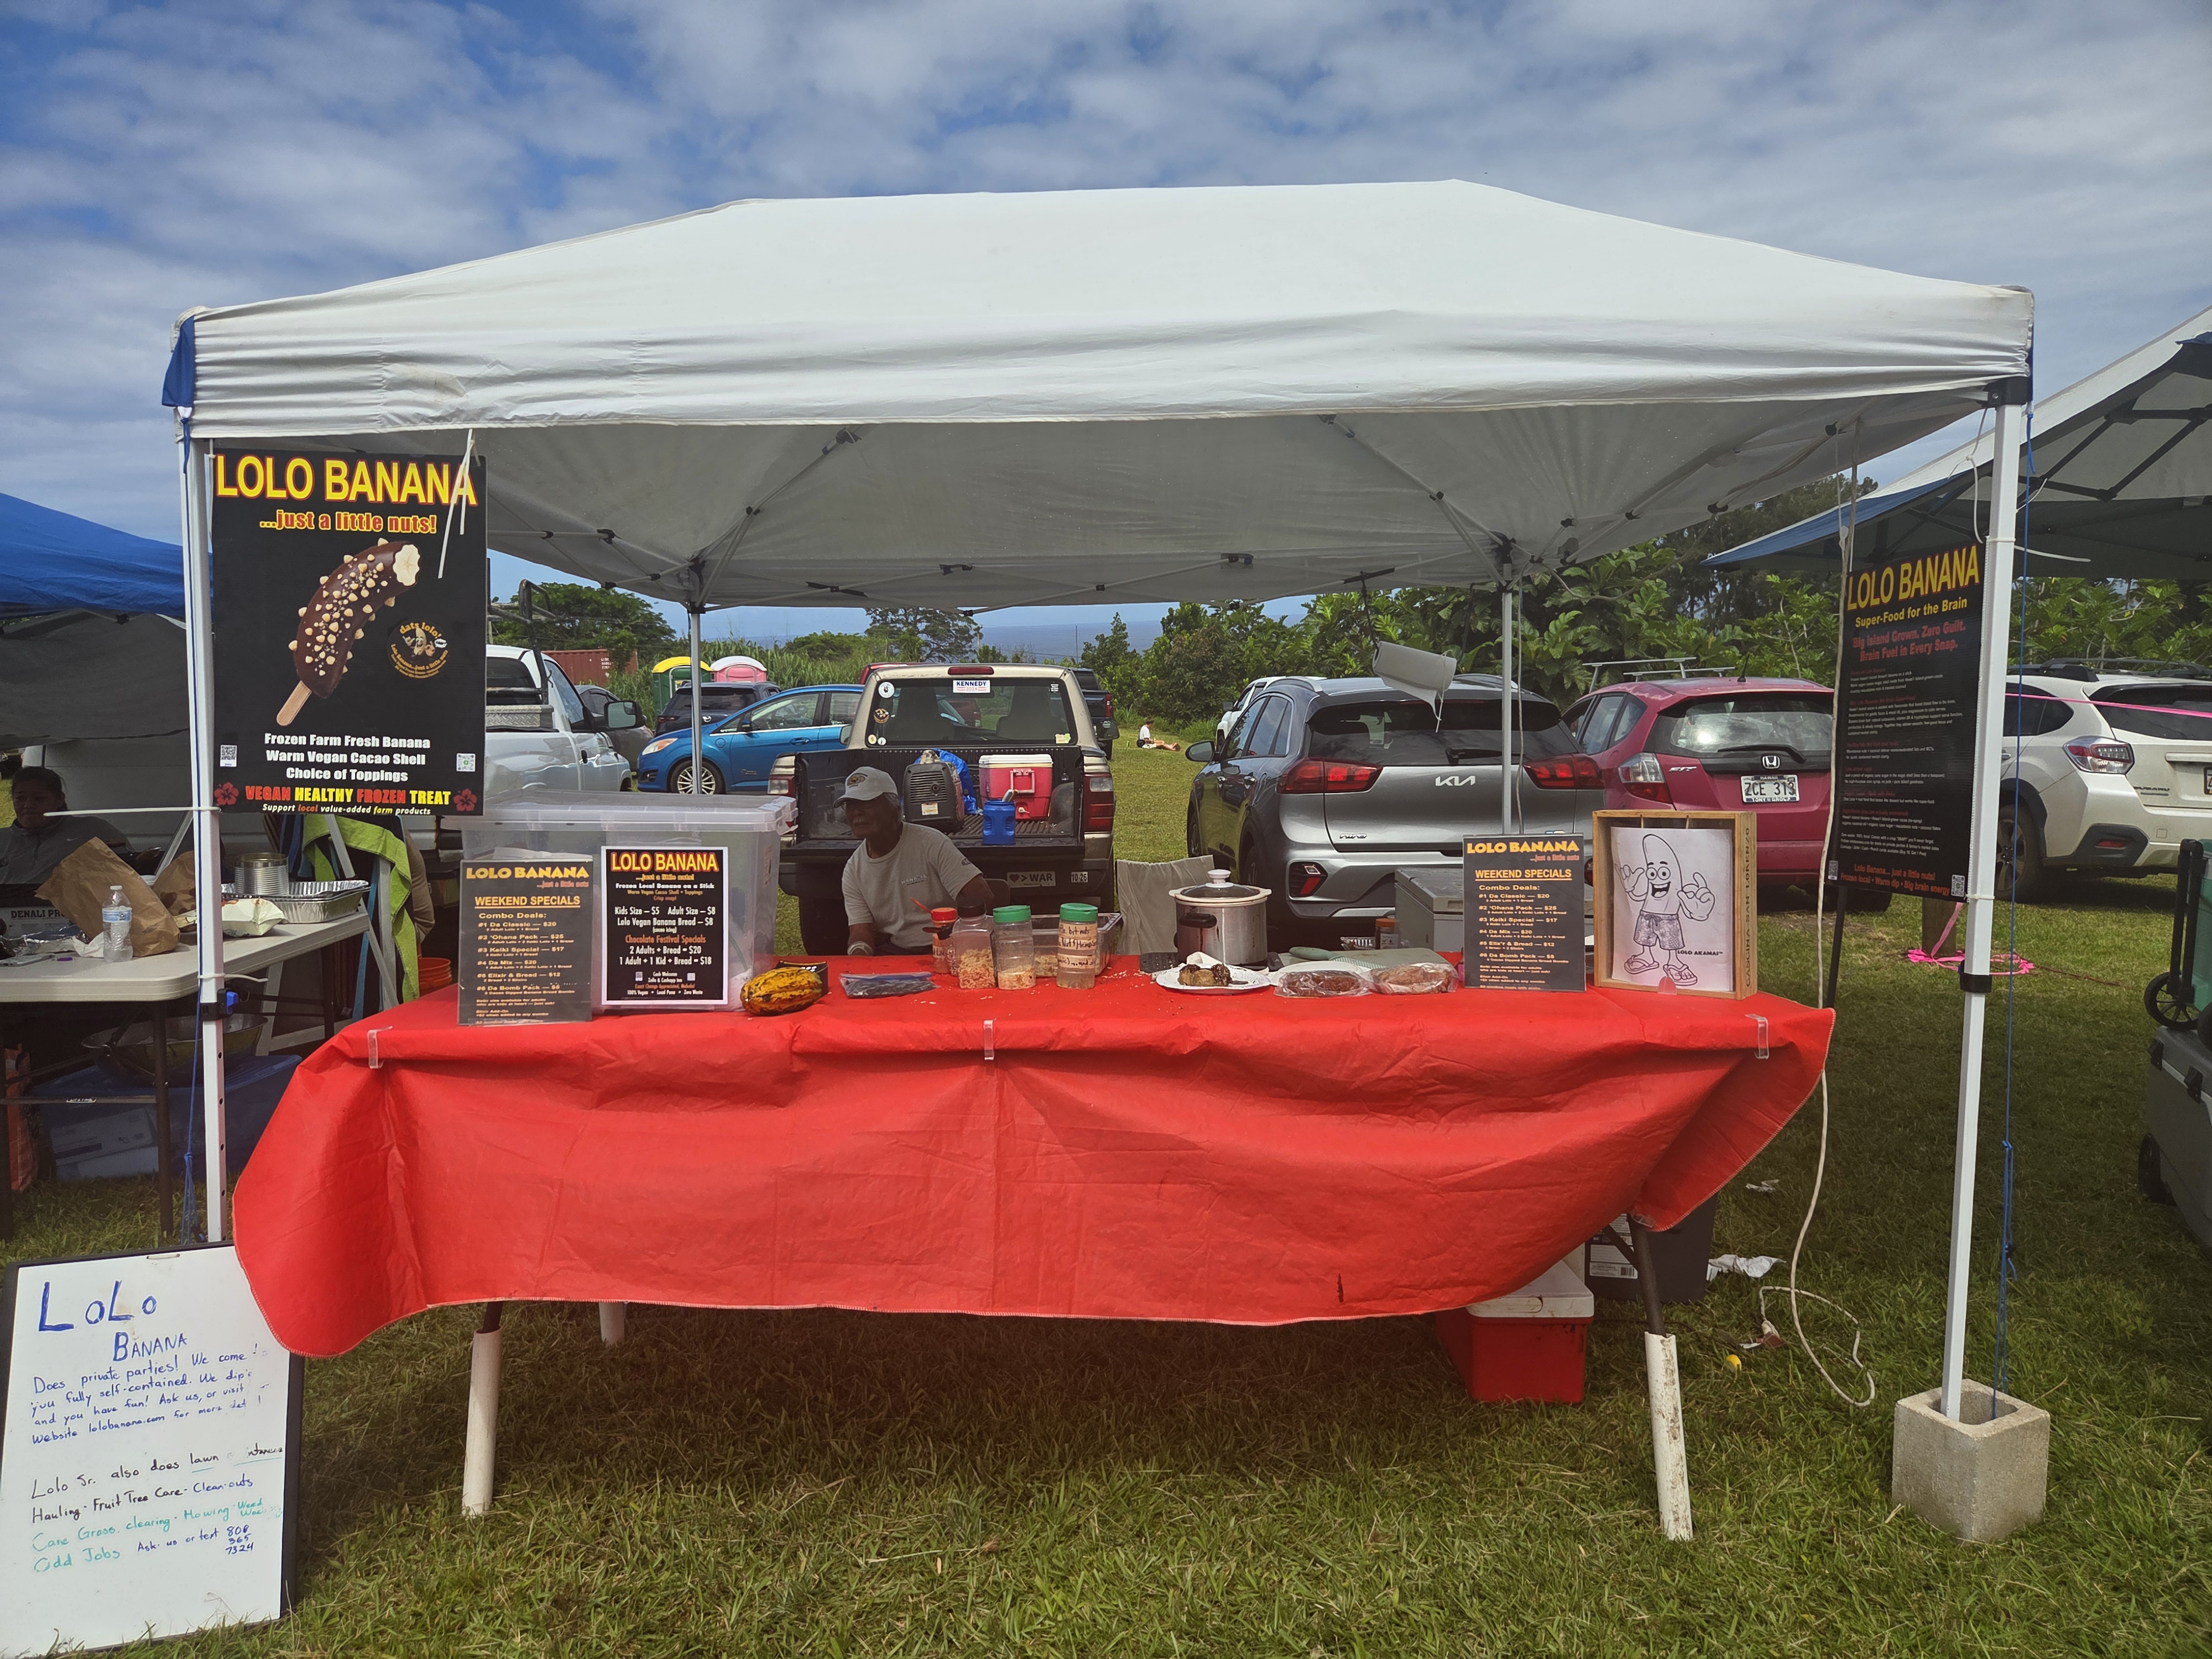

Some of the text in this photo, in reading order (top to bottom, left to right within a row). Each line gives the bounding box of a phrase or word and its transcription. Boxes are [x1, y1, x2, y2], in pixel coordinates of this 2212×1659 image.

[217, 455, 478, 506] LOLO BANANA
[260, 510, 437, 534] ...just a little nuts!
[1847, 544, 1980, 611] LOLO BANANA
[1855, 597, 1968, 628] Super-Food for the Brain
[400, 622, 442, 639] dats lolo!
[1853, 619, 1966, 649] Big Island Grown. Zero Guilt.
[1860, 638, 1958, 661] Brain Fuel in Every Snap.
[264, 733, 430, 748] Frozen Farm Fresh Banana
[266, 750, 426, 765] Warm Vegan Cacao Shell
[286, 768, 408, 782] Choice of Toppings
[1436, 775, 1475, 786] KIA
[245, 785, 451, 805] VEGAN HEALTHY FROZEN TREAT
[1744, 782, 1766, 796] ZCE
[263, 804, 431, 815] Support local value-added farm products
[1467, 841, 1579, 854] LOLO BANANA
[611, 852, 719, 872] LOLO BANANA
[466, 867, 589, 879] LOLO BANANA
[1030, 873, 1053, 881] WAR
[1475, 869, 1572, 878] WEEKEND SPECIALS
[1904, 880, 1913, 891] Big
[1914, 881, 1929, 891] brain
[474, 896, 580, 906] WEEKEND SPECIALS
[615, 906, 716, 915] Kids Size $5 Adult Size $8
[618, 917, 630, 926] Lolo
[632, 918, 651, 927] Vegan
[678, 917, 696, 926] Bread
[705, 917, 713, 926] $8
[625, 935, 706, 945] Chocolate Festival Specials
[113, 1332, 187, 1361] BANANA
[34, 1352, 247, 1394] Does private parties! We come
[66, 1391, 91, 1407] fully
[100, 1373, 192, 1397] self-contained.
[200, 1373, 218, 1383] We
[34, 1412, 56, 1425] and
[64, 1413, 83, 1426] you
[94, 1406, 118, 1415] have
[124, 1395, 148, 1408] fun!
[186, 1394, 202, 1402] us,
[223, 1383, 244, 1395] visit
[90, 1416, 165, 1432] lolobanana.com
[32, 1477, 67, 1499] Lolo
[111, 1465, 139, 1478] also
[150, 1459, 179, 1471] does
[190, 1453, 219, 1464] lawn
[33, 1505, 81, 1523] Hauling
[93, 1494, 121, 1511] Fruit
[124, 1490, 148, 1503] Tree
[32, 1532, 69, 1552] Cane
[126, 1515, 170, 1532] clearing
[184, 1507, 229, 1521] Mowing
[238, 1498, 263, 1509] Weed
[228, 1534, 252, 1545] 365
[226, 1542, 253, 1555] 7324
[34, 1553, 72, 1572] Odd
[82, 1547, 120, 1562] Jobs
